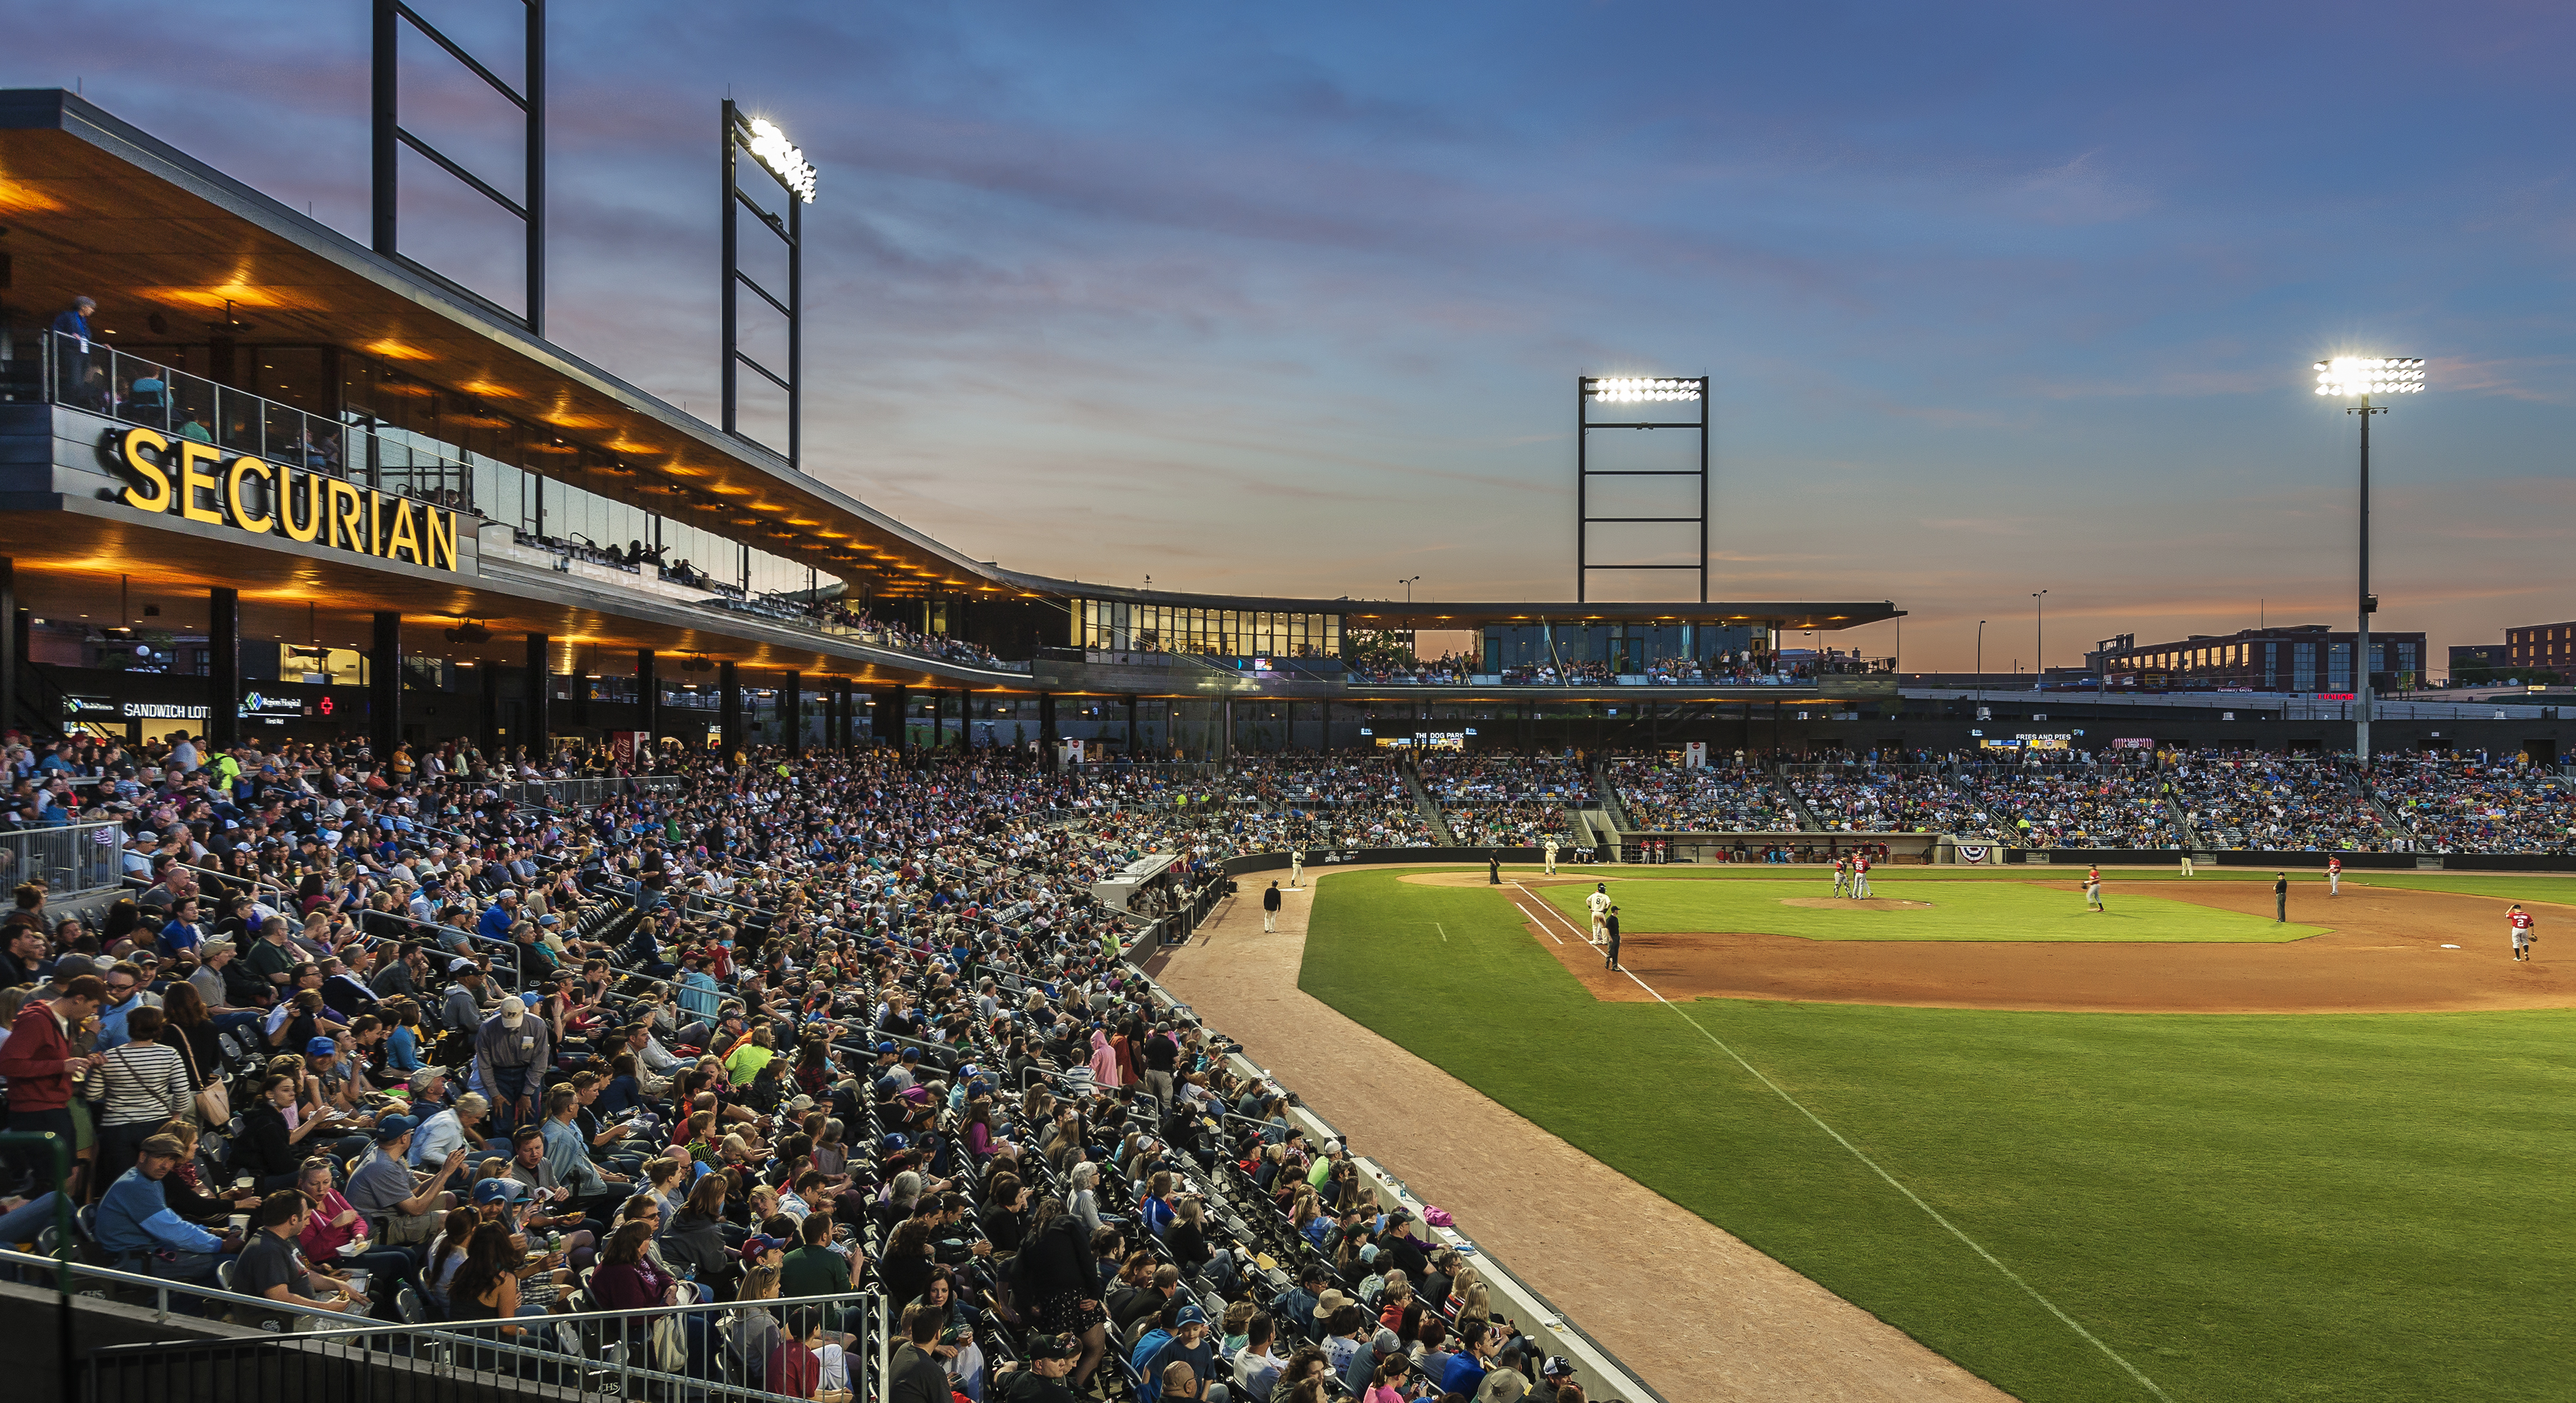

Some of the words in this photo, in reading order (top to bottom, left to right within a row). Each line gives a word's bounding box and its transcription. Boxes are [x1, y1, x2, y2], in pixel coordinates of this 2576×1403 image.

[123, 428, 458, 572] SECURIAN
[262, 698, 280, 708] Regions
[123, 704, 185, 719] SANDWICH
[188, 706, 207, 719] LOT
